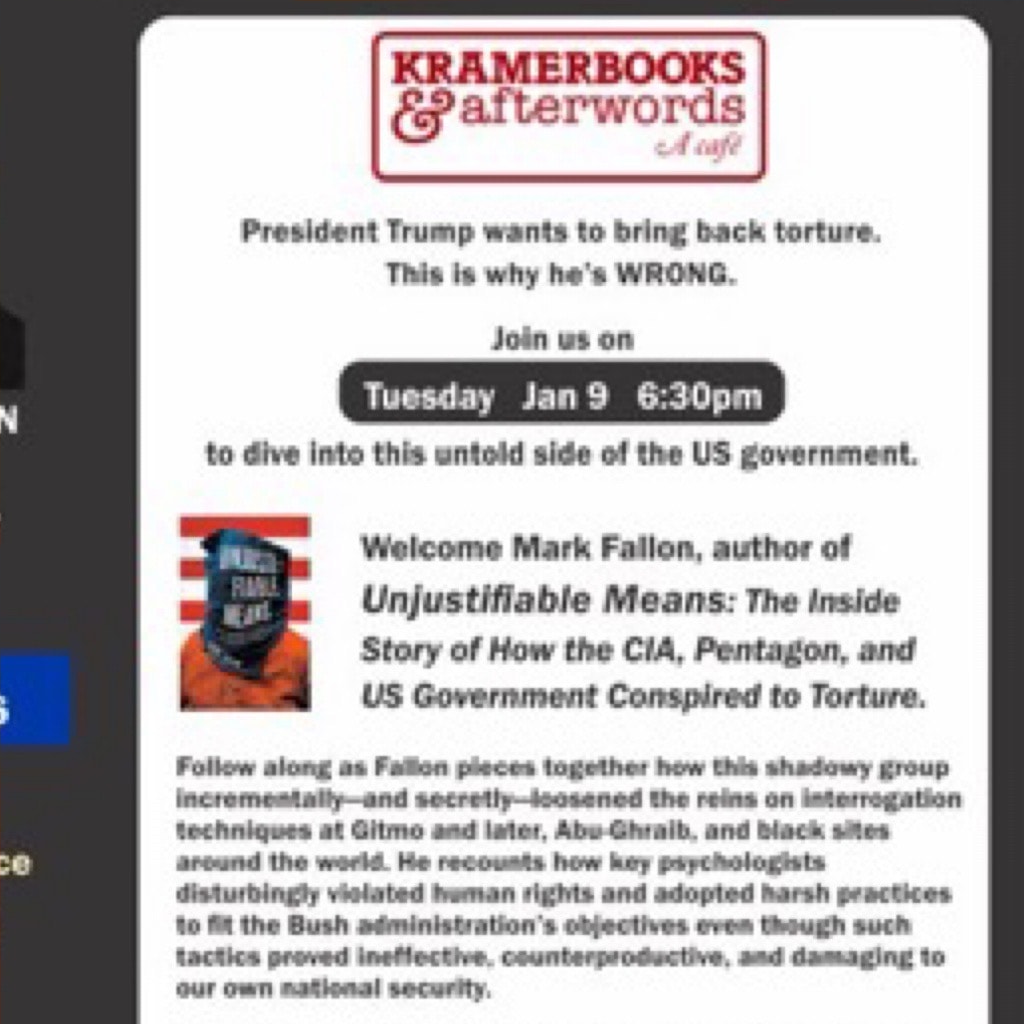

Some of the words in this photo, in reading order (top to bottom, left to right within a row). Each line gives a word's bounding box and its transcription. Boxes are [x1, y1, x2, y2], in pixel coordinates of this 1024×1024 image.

[391, 51, 746, 84] KRAMERBOOKS
[241, 218, 378, 243] President
[386, 218, 476, 247] Trump
[481, 221, 569, 243] wants
[576, 221, 607, 243] to
[613, 218, 688, 247] bring
[695, 219, 767, 243] back
[773, 221, 881, 243] torture.
[385, 262, 445, 285] This
[453, 262, 477, 285] is
[485, 262, 540, 291] why
[616, 262, 735, 286] WRONG.
[492, 326, 549, 351] Join
[557, 333, 592, 351] us
[597, 333, 635, 351] on
[363, 381, 496, 415] Tuesday
[521, 381, 577, 410] Jan
[587, 381, 609, 410] 9
[636, 381, 763, 415] 6:30pm
[206, 441, 234, 466] to
[242, 441, 301, 466] dive
[309, 441, 365, 466] into
[373, 441, 427, 466] this
[434, 441, 525, 466] untold
[533, 441, 592, 466] side
[600, 440, 628, 466] of
[636, 441, 684, 466] the
[691, 440, 732, 466] US
[740, 442, 918, 470] government.
[360, 535, 504, 561] Welcome
[512, 535, 592, 561] Mark
[600, 535, 703, 562] Fallon,
[711, 536, 813, 561] author
[819, 533, 851, 561] of
[361, 583, 592, 621] Unjustifiable
[603, 584, 736, 614] Means:
[745, 588, 799, 614] The
[807, 588, 901, 613] Inside
[361, 636, 444, 669] Story
[449, 636, 484, 662] of
[488, 636, 556, 662] How
[564, 637, 615, 662] the
[622, 636, 685, 664] CIA,
[693, 636, 849, 669] Pentagon,
[858, 637, 918, 662] and
[361, 683, 404, 709] US
[412, 683, 599, 709] Government
[607, 683, 763, 713] Conspired
[769, 684, 802, 709] to
[811, 683, 926, 709] Torture.
[175, 755, 257, 777] Follow
[262, 756, 333, 781] along
[338, 761, 369, 777] as
[373, 755, 449, 777] Fallon
[456, 760, 537, 781] pieces
[541, 757, 649, 781] together
[656, 757, 707, 777] how
[711, 757, 759, 777] this
[764, 757, 873, 781] shadowy
[878, 760, 951, 781] group
[648, 789, 691, 809] the
[696, 790, 759, 809] reins
[763, 791, 795, 808] on
[802, 788, 963, 813] interrogation
[175, 819, 313, 844] techniques
[318, 822, 345, 841] at
[350, 819, 425, 840] Gitmo
[430, 819, 478, 840] and
[485, 819, 548, 841] later,
[553, 819, 699, 841] Abu-Ghraib,
[704, 820, 751, 840] and
[756, 819, 827, 841] black
[831, 822, 891, 841] sites
[175, 851, 262, 872] around
[267, 851, 310, 872] the
[314, 851, 389, 872] world.
[397, 851, 432, 872] He
[437, 854, 547, 872] recounts
[552, 851, 604, 872] how
[608, 851, 652, 876] key
[657, 851, 827, 876] psychologists
[175, 882, 321, 908] disturbingly
[326, 882, 425, 904] violated
[432, 883, 517, 904] human
[521, 882, 596, 908] rights
[600, 882, 648, 904] and
[652, 882, 756, 908] adopted
[760, 882, 831, 904] harsh
[836, 882, 954, 907] practices
[175, 917, 202, 936] to
[206, 914, 234, 936] fit
[238, 914, 282, 936] the
[286, 914, 350, 936] Bush
[564, 914, 691, 940] objectives
[695, 918, 755, 936] even
[759, 914, 847, 940] though
[852, 914, 911, 936] such
[175, 946, 262, 967] tactics
[266, 946, 350, 970] proved
[357, 946, 493, 967] ineffective,
[500, 946, 731, 970] counterproductive,
[737, 946, 784, 967] and
[791, 946, 915, 971] damaging
[919, 947, 947, 967] to
[175, 982, 218, 999] our
[222, 982, 274, 999] own
[279, 977, 382, 999] national
[388, 978, 492, 1003] security.
